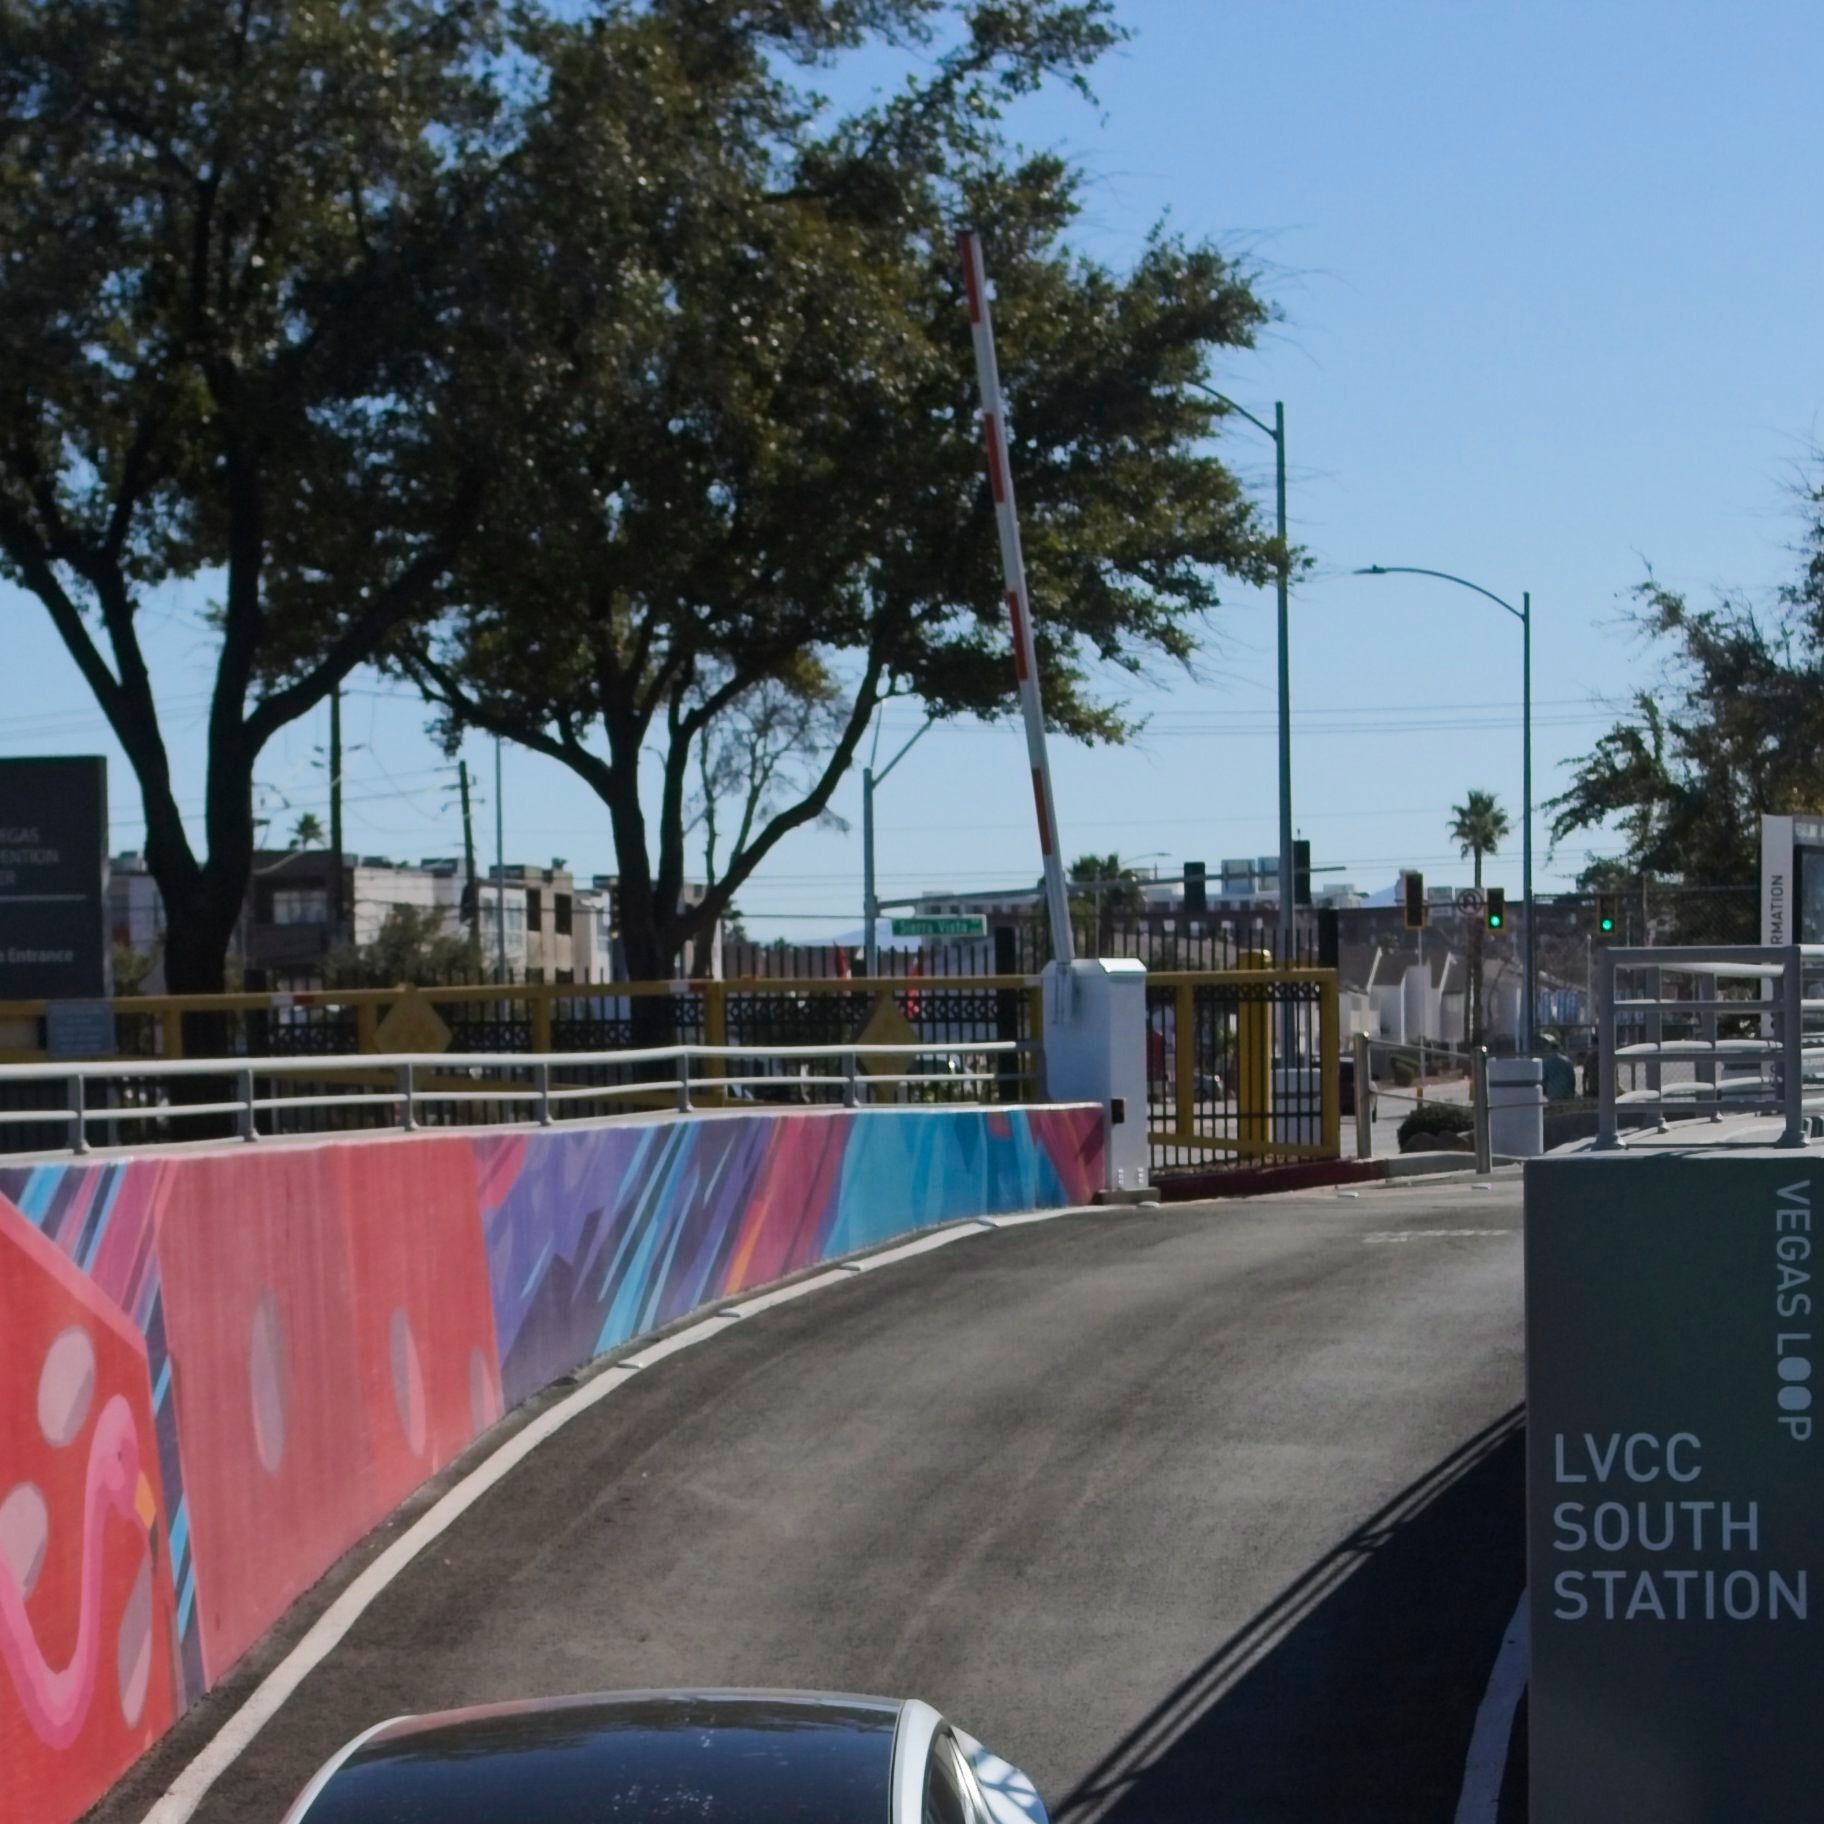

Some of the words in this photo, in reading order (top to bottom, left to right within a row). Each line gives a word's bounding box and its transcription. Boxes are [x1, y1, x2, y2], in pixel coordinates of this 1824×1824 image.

[1770, 874, 1784, 944] RMATION
[7, 947, 75, 964] Entrance
[1777, 1179, 1812, 1318] VEGAS
[1777, 1332, 1812, 1441] LOOP
[1555, 1432, 1703, 1484] LVCC
[1553, 1501, 1759, 1552] SOUTH
[1554, 1569, 1808, 1621] STATION
